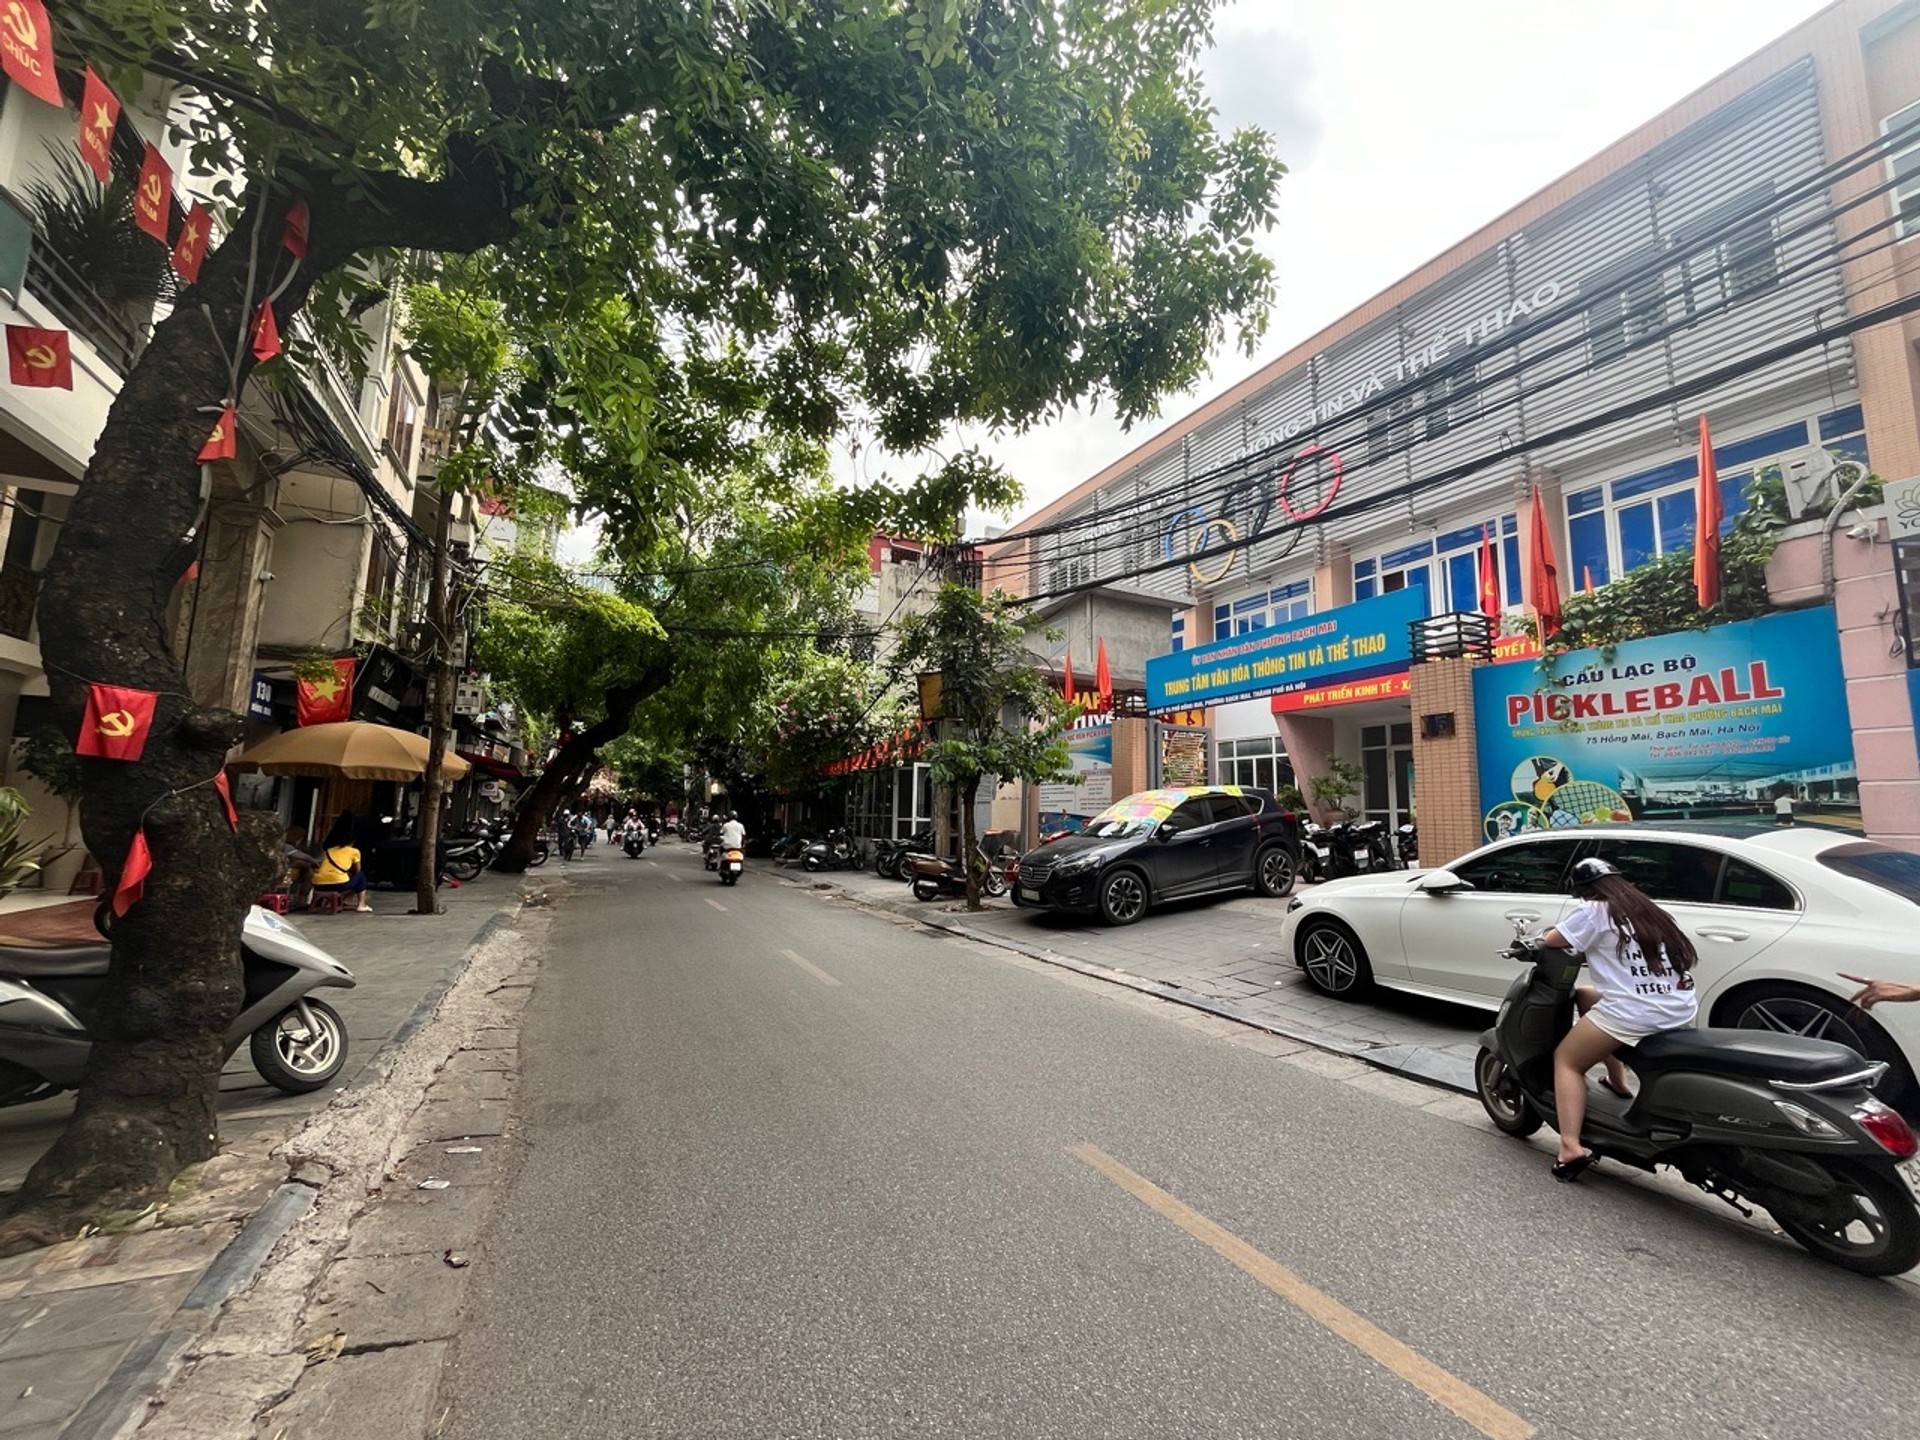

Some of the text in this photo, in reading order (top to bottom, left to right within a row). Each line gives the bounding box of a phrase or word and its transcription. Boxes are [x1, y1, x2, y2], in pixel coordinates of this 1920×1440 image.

[1391, 327, 1450, 381] THỂ
[1458, 281, 1561, 346] THAO
[1318, 620, 1338, 634] MAI
[1164, 632, 1386, 697] TRUNG TÂM VĂN HÓA THÔNG TIN VÀ THỂ THAO
[1612, 662, 1655, 681] LẠC
[1663, 654, 1697, 673] BỘ
[1303, 693, 1325, 704] PHÁT
[1327, 684, 1353, 701] TRIỂN
[1354, 683, 1378, 697] KINH
[1381, 680, 1392, 693] TẾ
[1507, 660, 1785, 727] PICKLEBALL
[1761, 703, 1783, 715] MAI
[1656, 730, 1686, 741] Bạch
[1717, 724, 1734, 735] Hà
